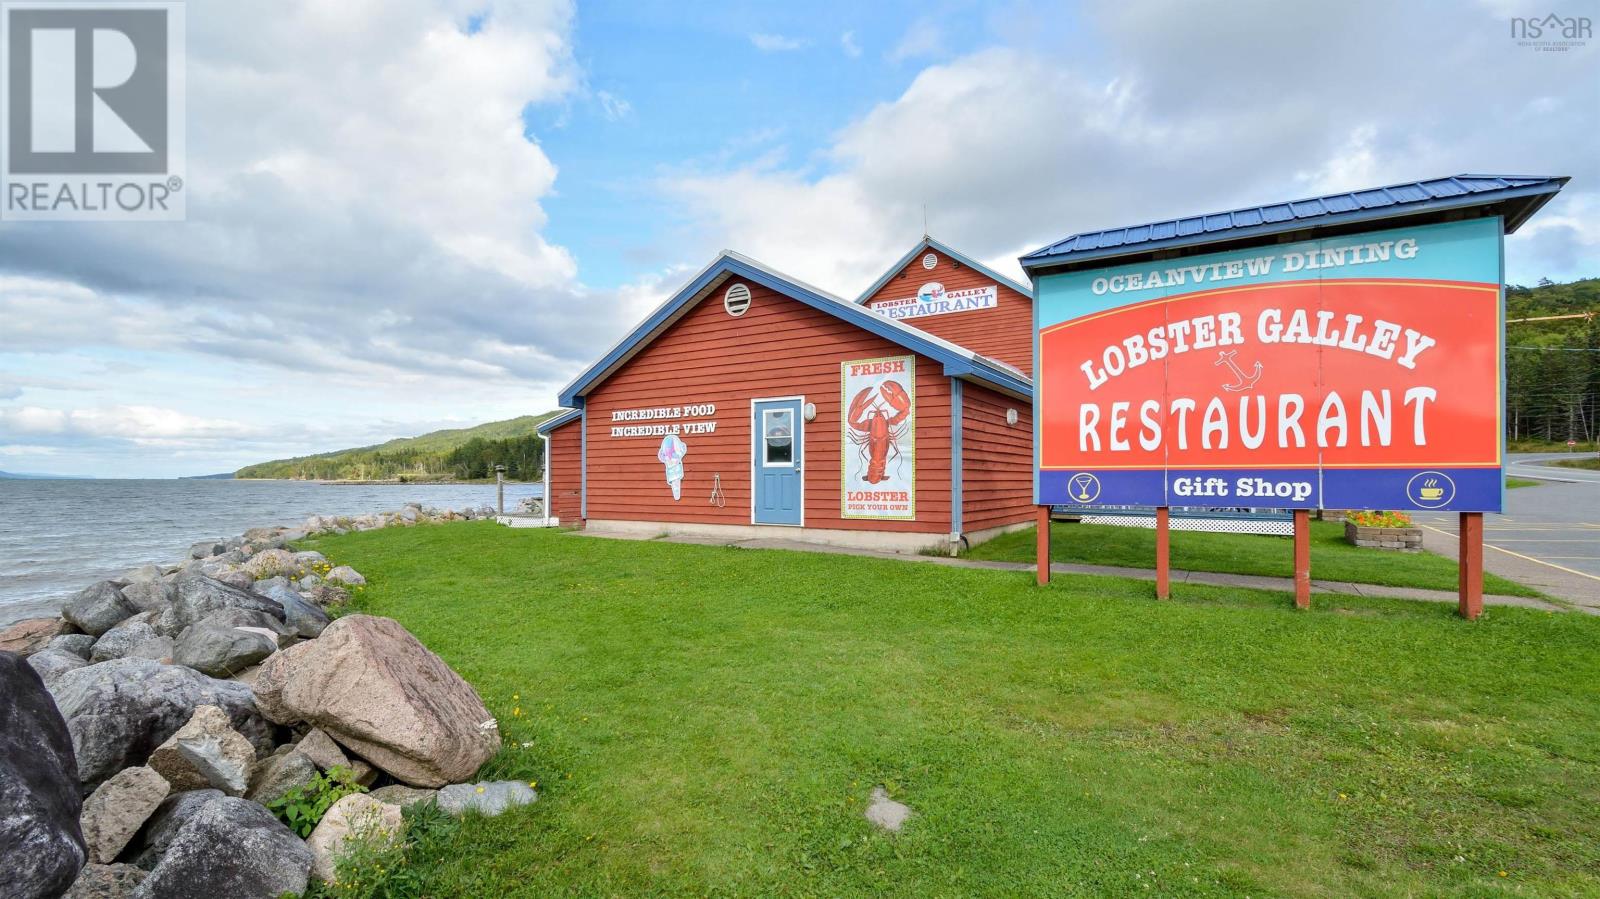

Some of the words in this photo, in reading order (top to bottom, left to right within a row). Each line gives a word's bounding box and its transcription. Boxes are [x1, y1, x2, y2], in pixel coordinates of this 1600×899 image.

[1091, 255, 1276, 296] OCEANVIEW
[1282, 238, 1420, 274] DINING
[877, 298, 917, 309] LOBSTER
[947, 287, 988, 299] GALLEY
[1079, 311, 1245, 391] LOBSTER
[1257, 308, 1436, 370] GALLEY
[850, 360, 905, 377] FRESH
[611, 407, 681, 421] INCREDIBLE
[683, 404, 716, 417] FOOD
[1078, 386, 1438, 452] RESTAURANT
[610, 424, 680, 437] INCREDIBLE
[682, 422, 717, 434] VIEW
[847, 491, 909, 502] LOBSTER
[1173, 477, 1229, 497] Gift
[1235, 478, 1313, 501] Shop
